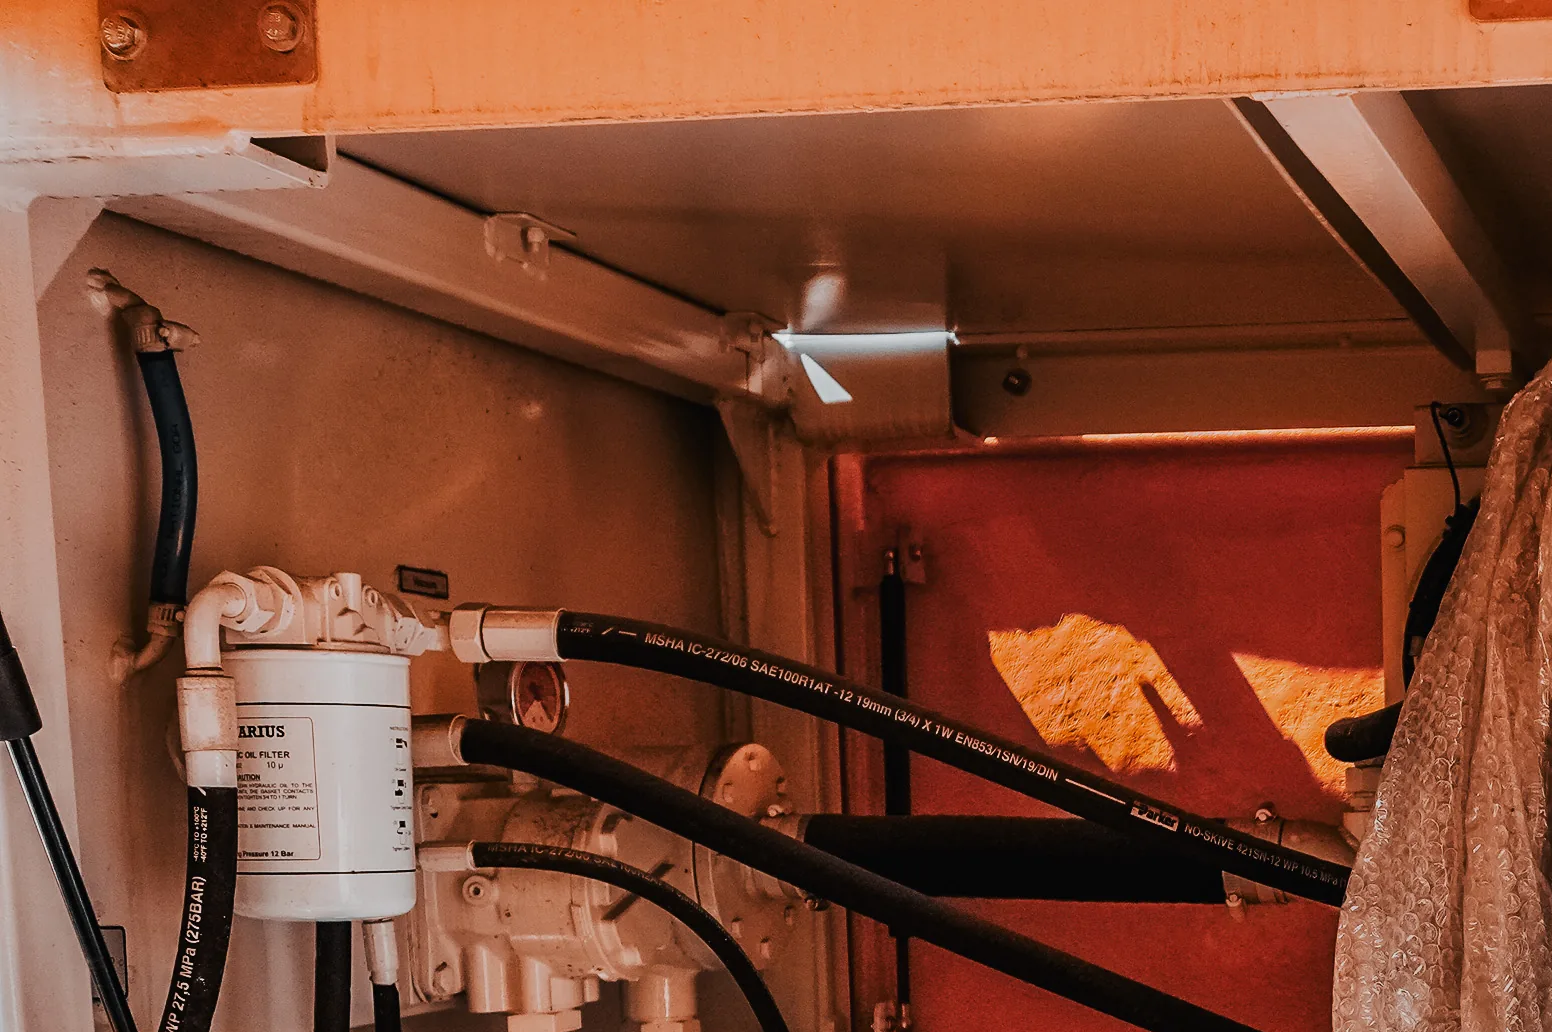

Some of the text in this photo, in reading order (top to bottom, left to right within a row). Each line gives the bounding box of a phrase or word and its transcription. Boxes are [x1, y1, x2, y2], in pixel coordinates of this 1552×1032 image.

[645, 632, 1059, 783] MSHA IC-272/06 SAE100R1AT -12 19mm (3/4) X 1W EN853/1SN/19/DIN
[238, 725, 285, 738] ARIUS
[245, 751, 257, 759] OIL
[259, 751, 290, 759] FILTER
[1184, 823, 1234, 851] NO-SKIVE
[1236, 843, 1281, 867] 421SN-12
[1283, 858, 1298, 872] WP
[186, 876, 207, 945] (275BAR)
[179, 947, 197, 982] MPa
[172, 981, 190, 1012] 27,5
